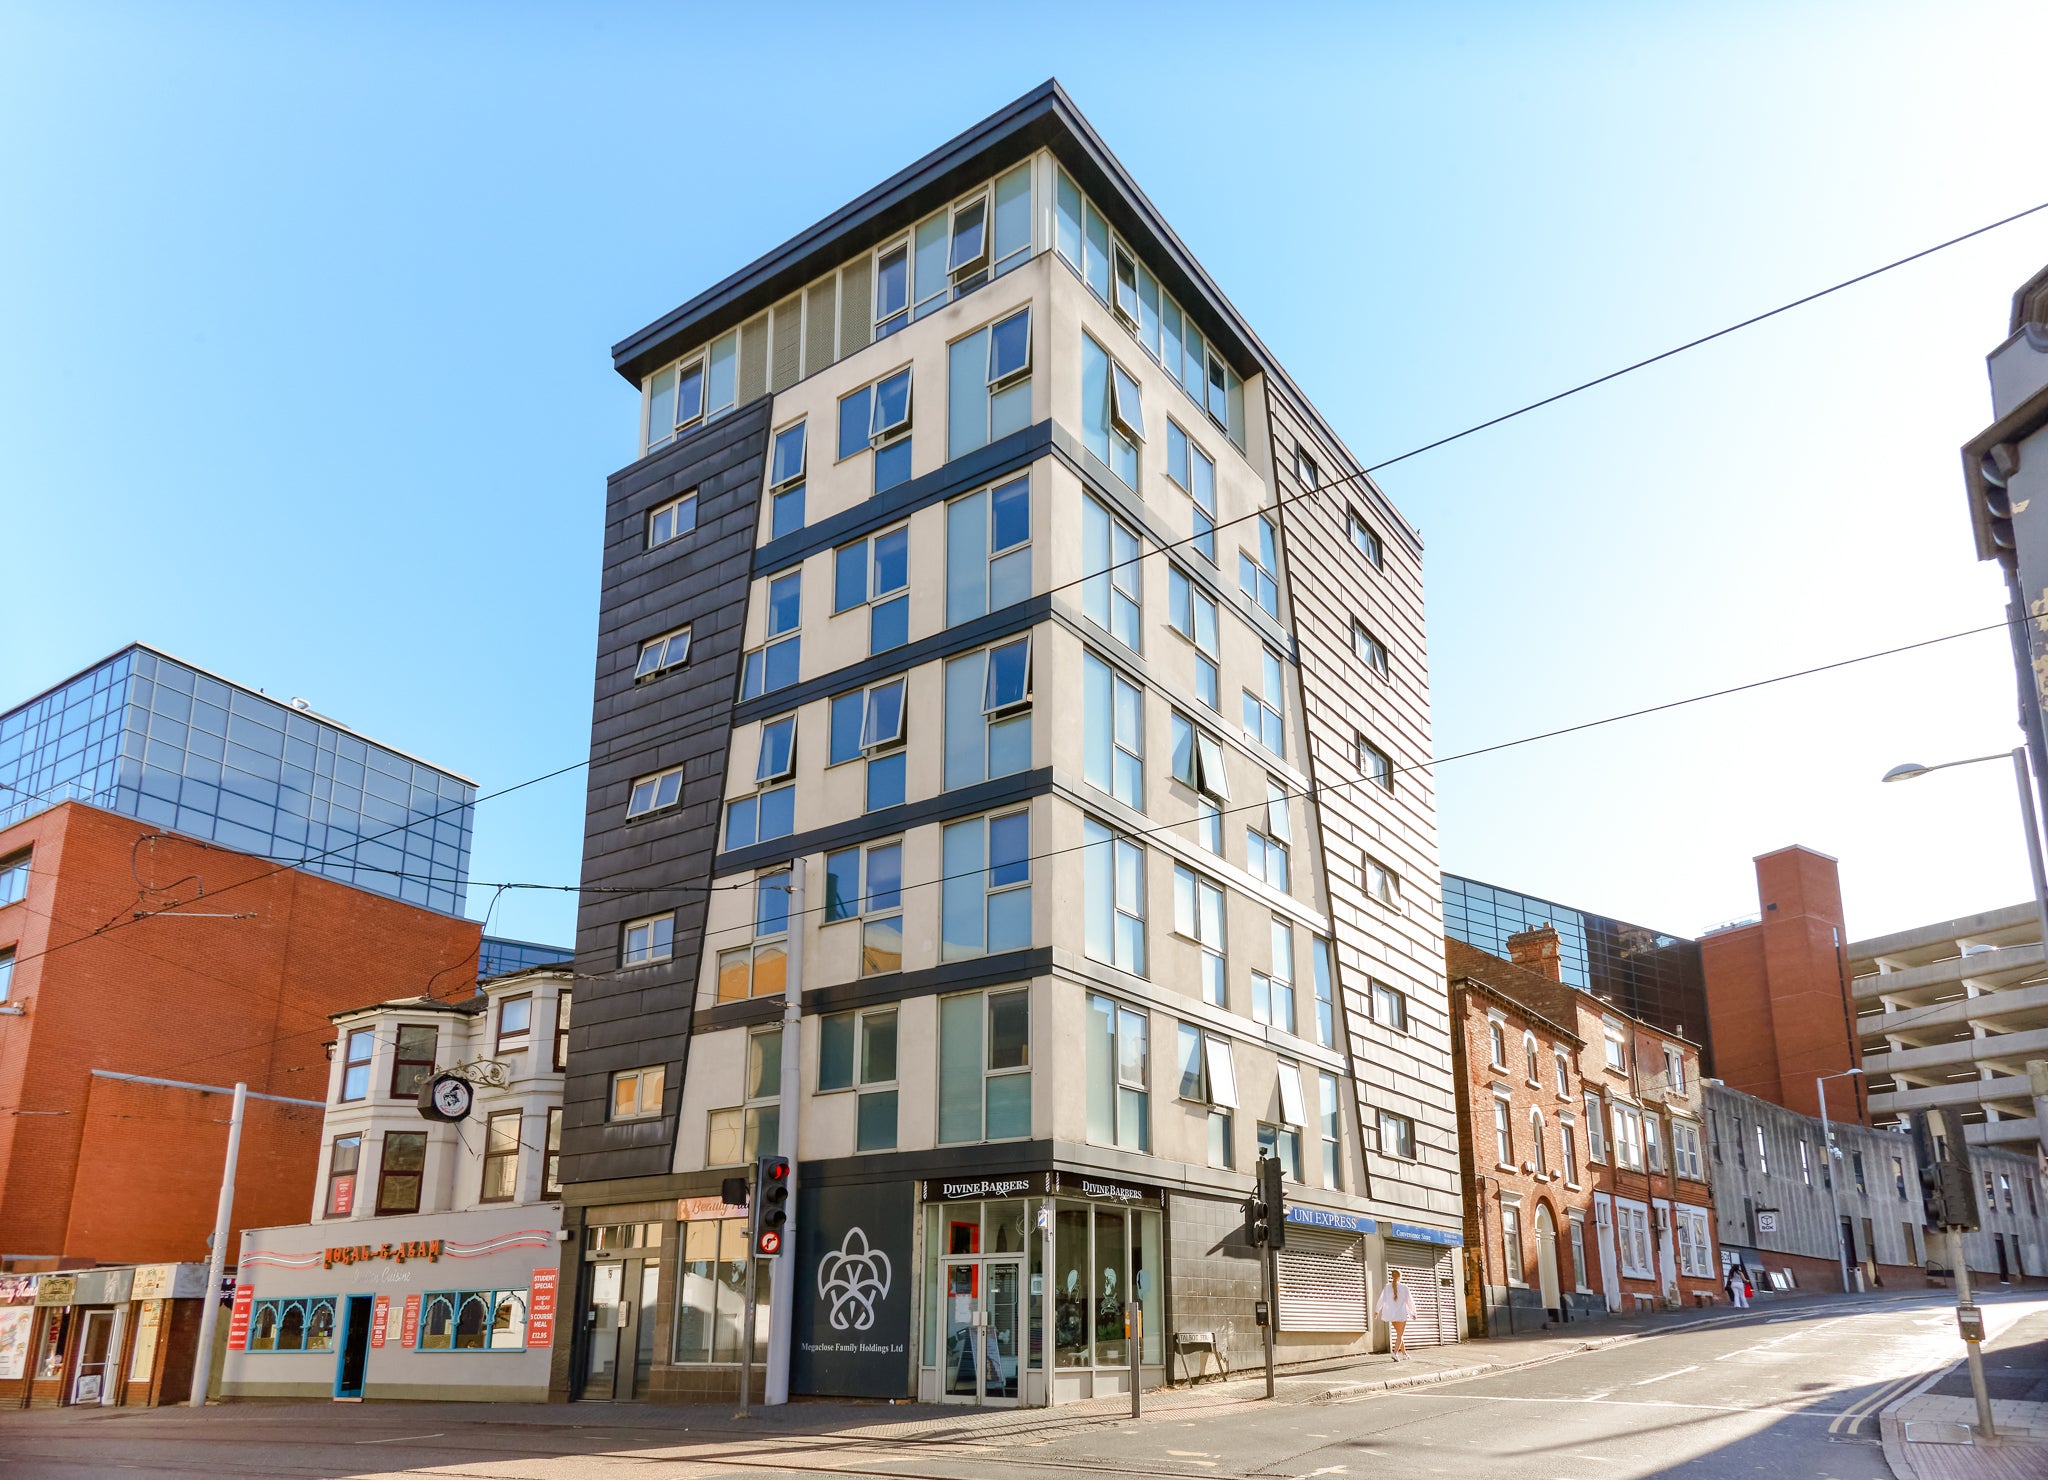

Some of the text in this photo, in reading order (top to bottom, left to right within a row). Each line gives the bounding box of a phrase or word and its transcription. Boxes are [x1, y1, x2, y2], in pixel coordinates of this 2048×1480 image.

[943, 1180, 1029, 1196] DIVINE BARBERS
[1082, 1181, 1143, 1200] DIVINE BARBERS
[1294, 1209, 1357, 1230] UNI EXPRESS
[1396, 1230, 1431, 1241] Convenience Store
[801, 1343, 903, 1354] Megaclose Family Holdings Ltd
